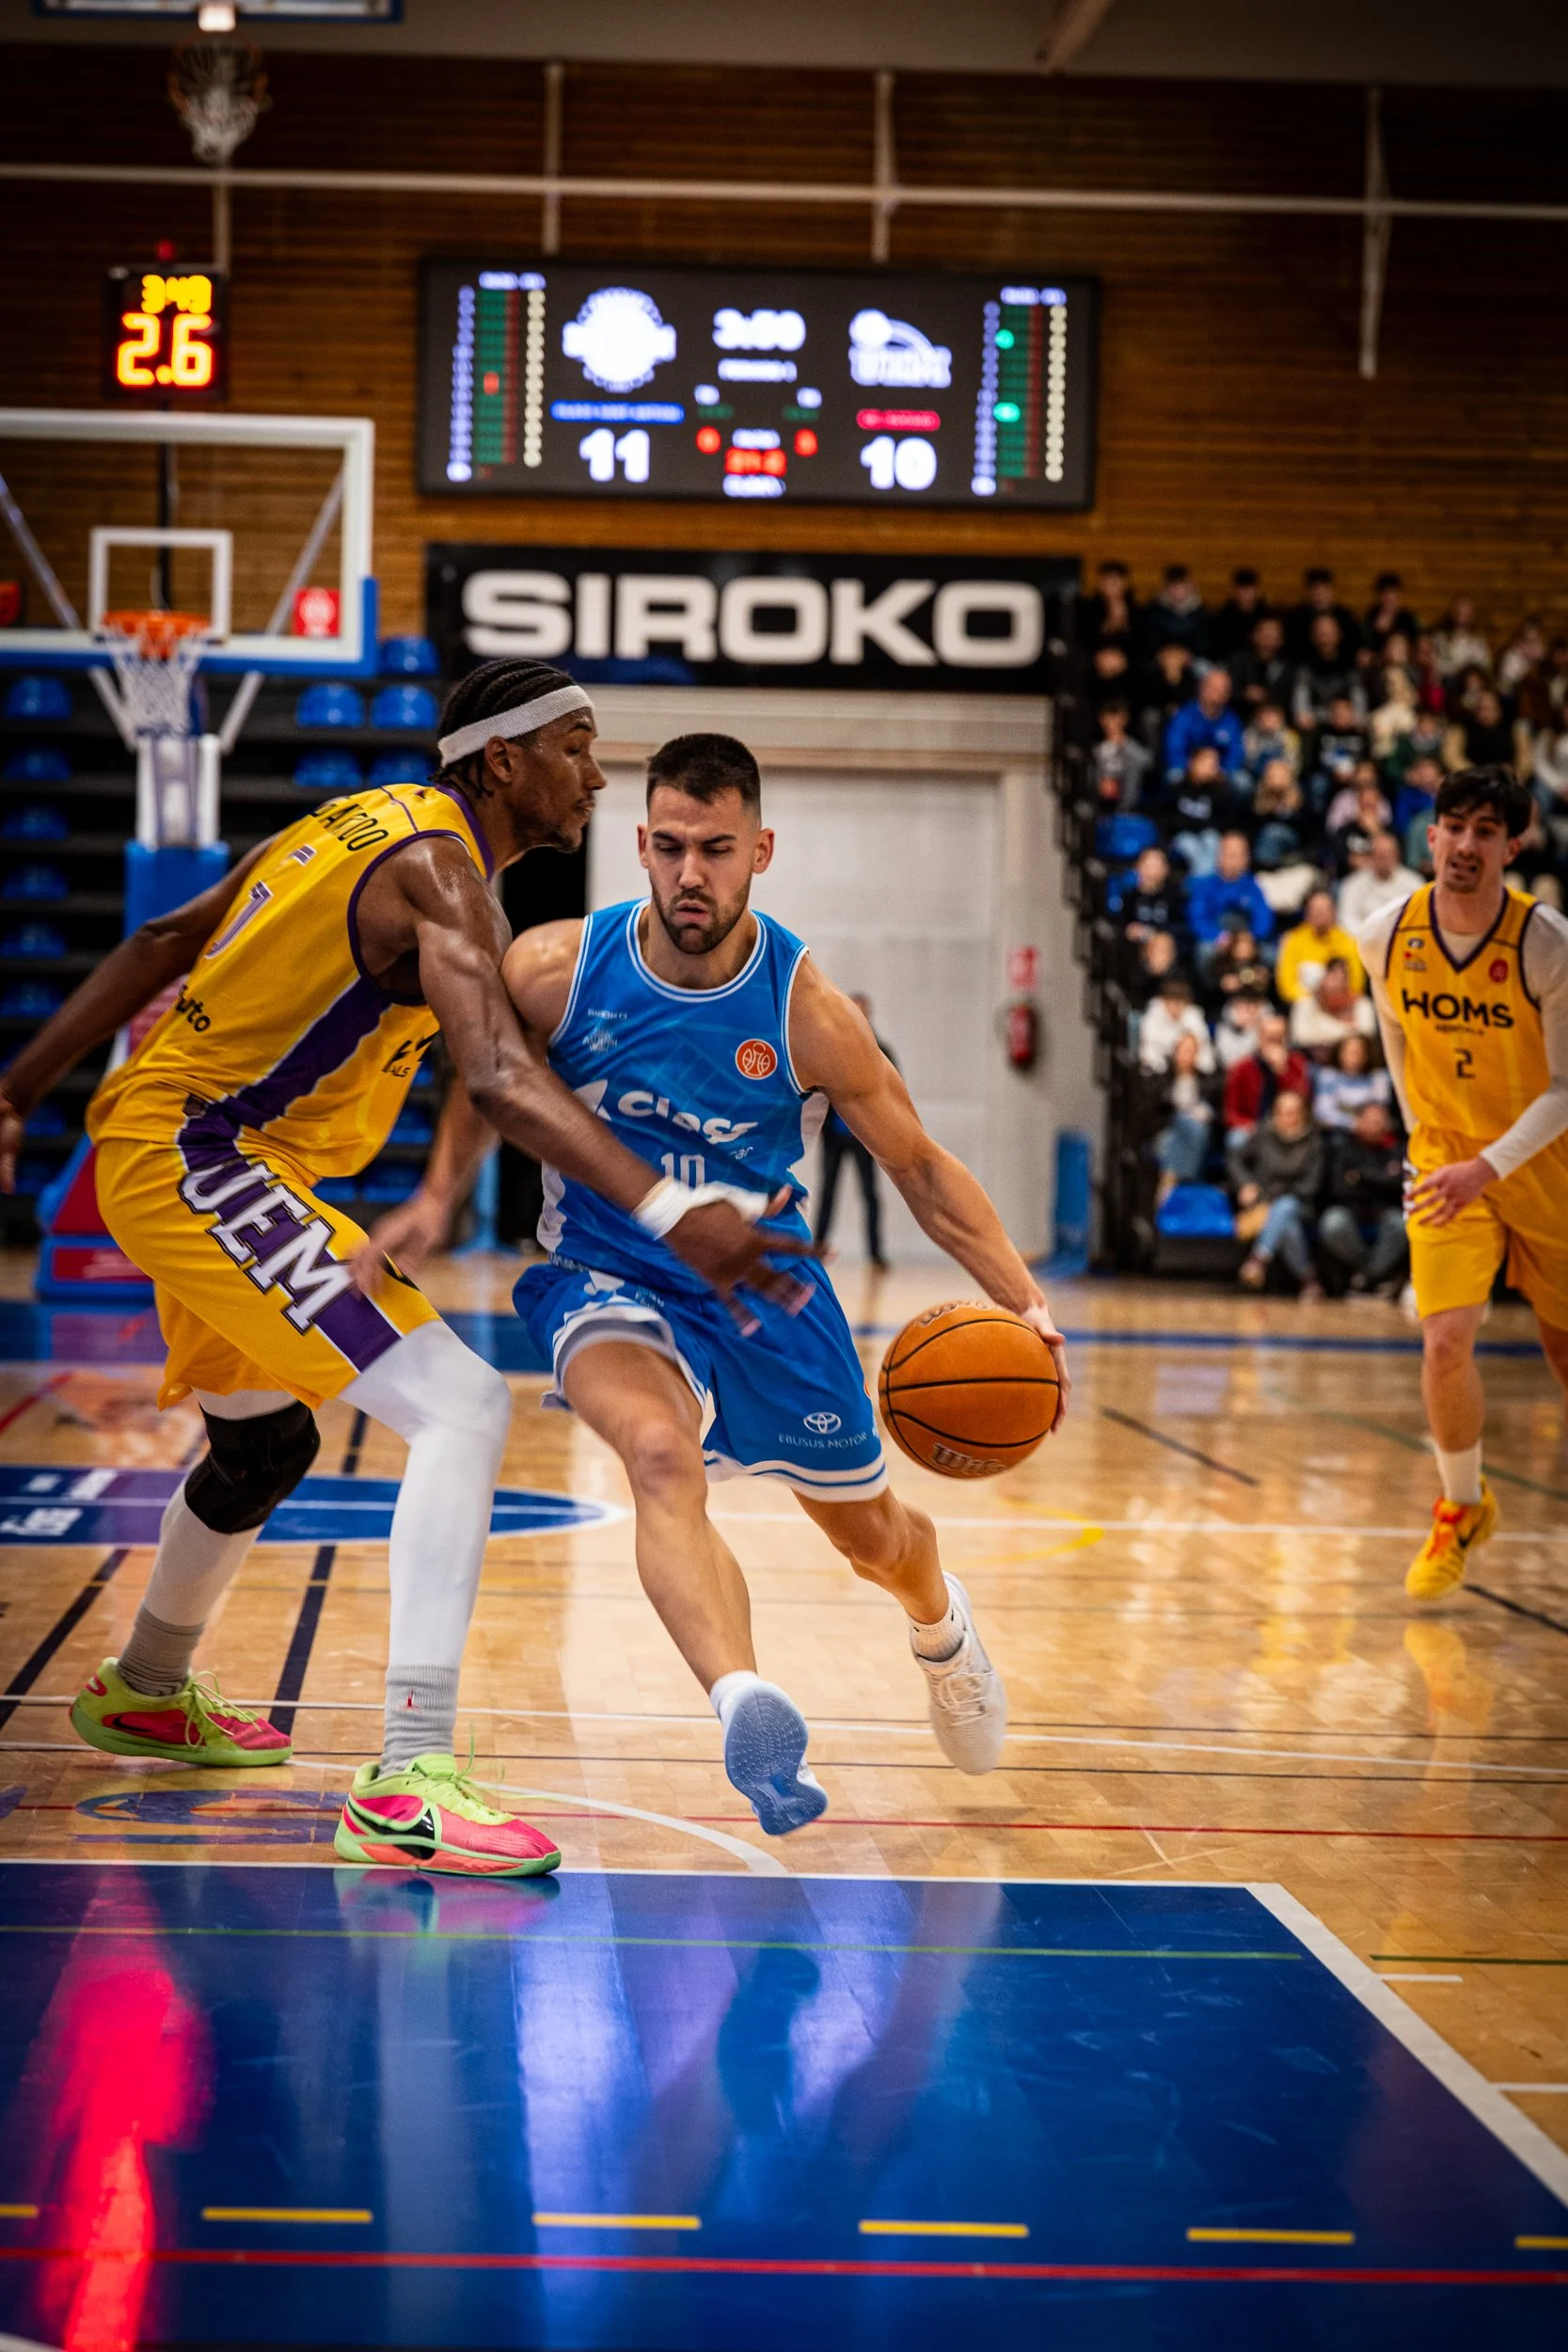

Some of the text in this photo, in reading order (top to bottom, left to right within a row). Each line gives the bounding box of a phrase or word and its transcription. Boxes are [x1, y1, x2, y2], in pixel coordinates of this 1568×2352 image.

[117, 312, 213, 387] 2.6
[578, 428, 650, 483] 11
[860, 435, 937, 490] 10
[462, 569, 1044, 667] SIROKO
[1402, 988, 1514, 1028] HOMS
[1454, 1047, 1477, 1079] 2
[661, 1152, 705, 1191] 10
[177, 1154, 354, 1336] UEM
